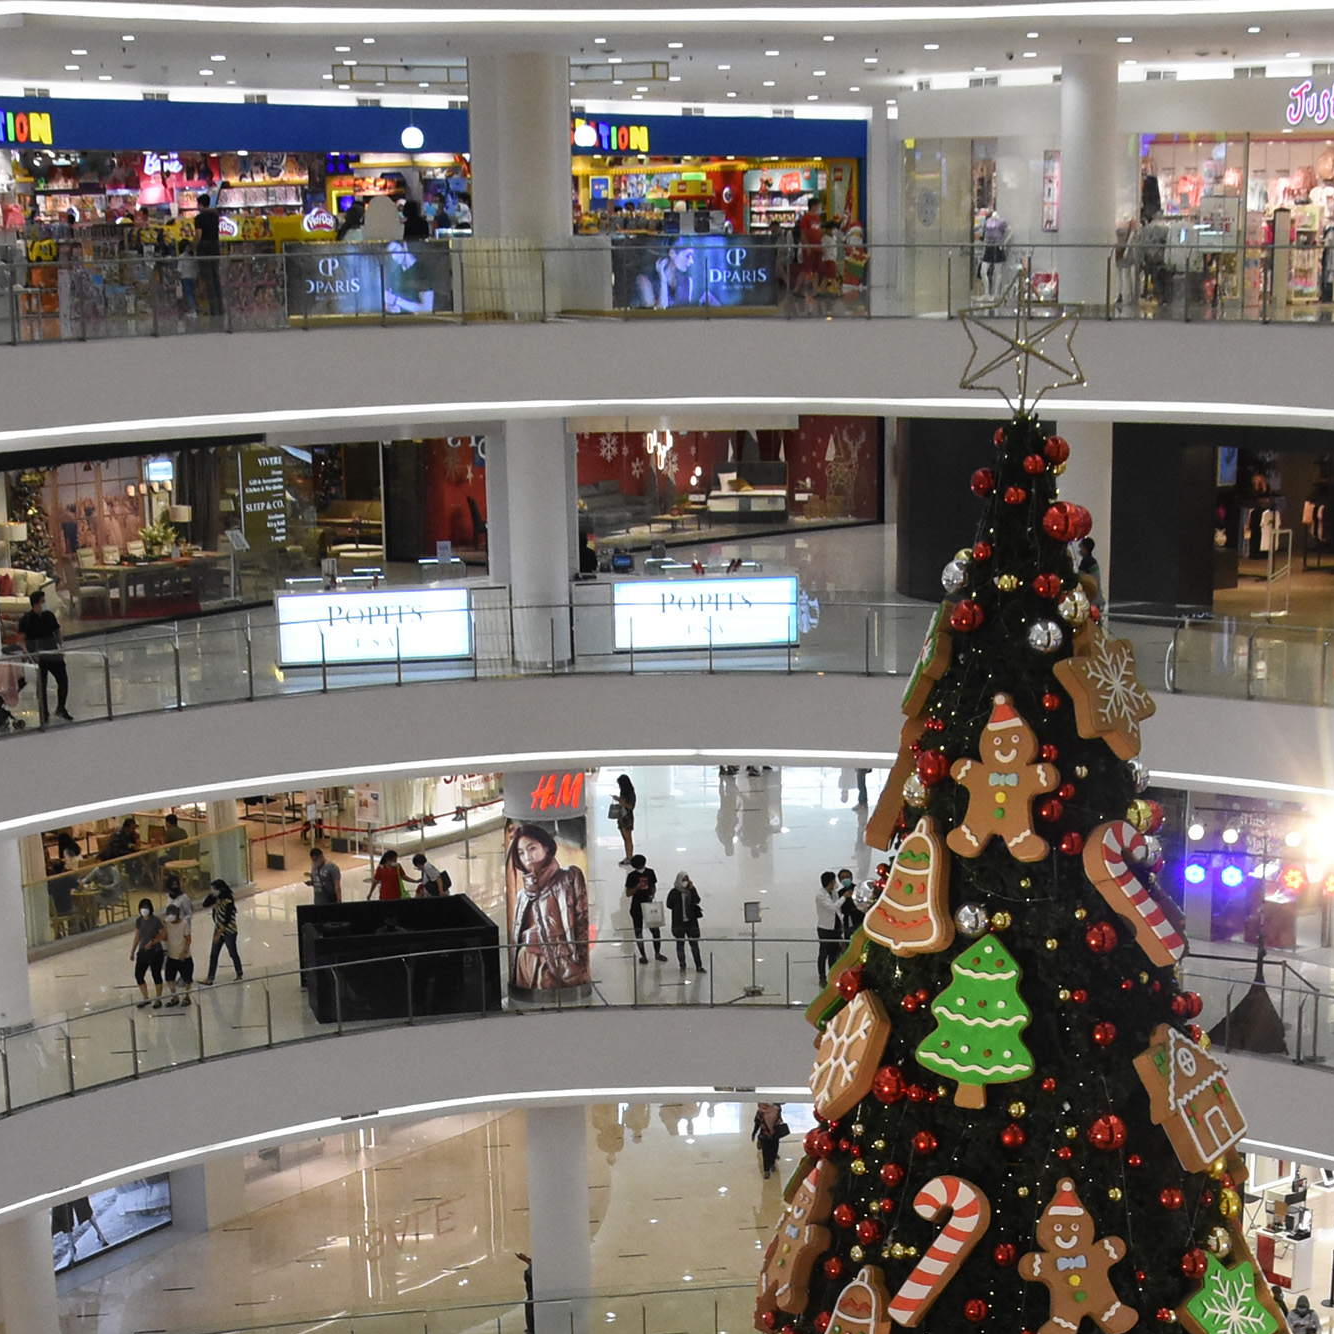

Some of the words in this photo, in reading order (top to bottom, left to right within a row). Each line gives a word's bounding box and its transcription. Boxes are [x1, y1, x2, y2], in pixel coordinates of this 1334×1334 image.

[257, 456, 283, 467] VIVERE
[245, 502, 265, 512] SLEEP
[531, 772, 584, 811] H&M
